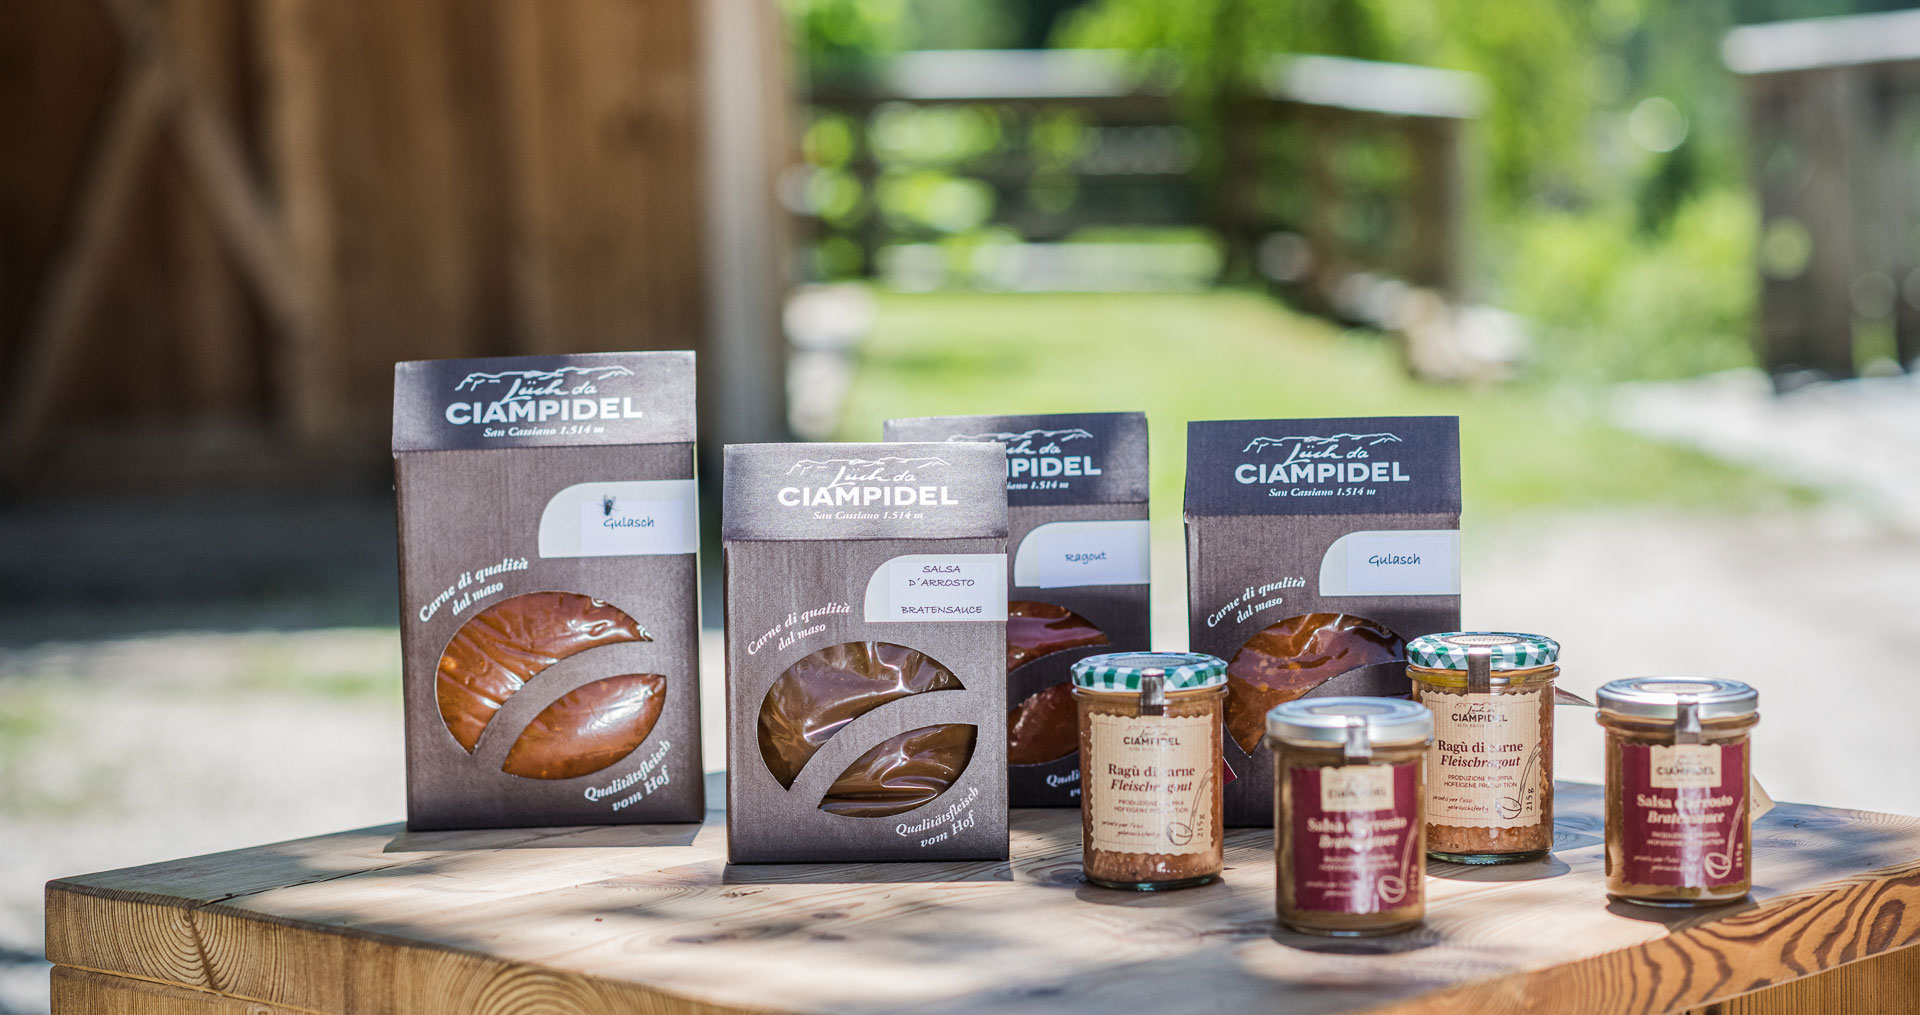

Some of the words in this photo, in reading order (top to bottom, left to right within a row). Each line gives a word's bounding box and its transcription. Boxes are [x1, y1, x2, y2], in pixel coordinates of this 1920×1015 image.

[571, 381, 598, 396] da
[445, 397, 643, 425] CIAMPIDEL
[483, 427, 505, 438] San
[508, 426, 557, 437] Cassiano
[560, 426, 592, 436] 1.514
[1039, 442, 1062, 454] da
[1346, 447, 1369, 459] da
[1007, 456, 1102, 478] PIDEL
[1234, 462, 1410, 484] CIAMPIDEL
[893, 469, 916, 482] da
[1007, 481, 1029, 490] iano
[1031, 480, 1057, 490] 1.514
[1268, 488, 1288, 497] San
[1290, 488, 1333, 496] Cassiano
[1336, 487, 1364, 496] 1.514
[778, 486, 959, 506] CIAMPIDEL
[603, 517, 655, 528] Gulasch
[812, 511, 833, 520] San
[835, 511, 879, 520] Cassiano
[883, 510, 912, 520] 1.514
[1065, 551, 1107, 564] Ragout
[1368, 553, 1421, 566] Gulasch
[922, 565, 961, 574] SALSA
[419, 585, 455, 622] Carne
[458, 571, 472, 589] di
[475, 557, 528, 583] qualità
[452, 592, 471, 616] dal
[472, 582, 504, 602] maso
[1207, 598, 1240, 628] Carne
[1242, 586, 1256, 601] di
[1258, 576, 1306, 595] qualità
[901, 605, 983, 615] BRATENSAUCE
[1236, 608, 1254, 624] dal
[1255, 595, 1283, 612] maso
[747, 625, 782, 655] Carne
[784, 611, 799, 627] di
[801, 602, 851, 623] qualità
[778, 631, 796, 651] dal
[797, 623, 826, 641] maso
[1438, 740, 1468, 754] Ragù
[1472, 741, 1485, 752] di
[584, 740, 671, 802] Qualitätsfleisch
[1108, 763, 1140, 778] Ragù
[1144, 766, 1157, 777] di
[612, 792, 642, 811] vom
[644, 764, 670, 795] Hof
[895, 786, 979, 837] Qualitätsfleisch
[920, 831, 948, 847] vom
[951, 810, 977, 836] Hof
